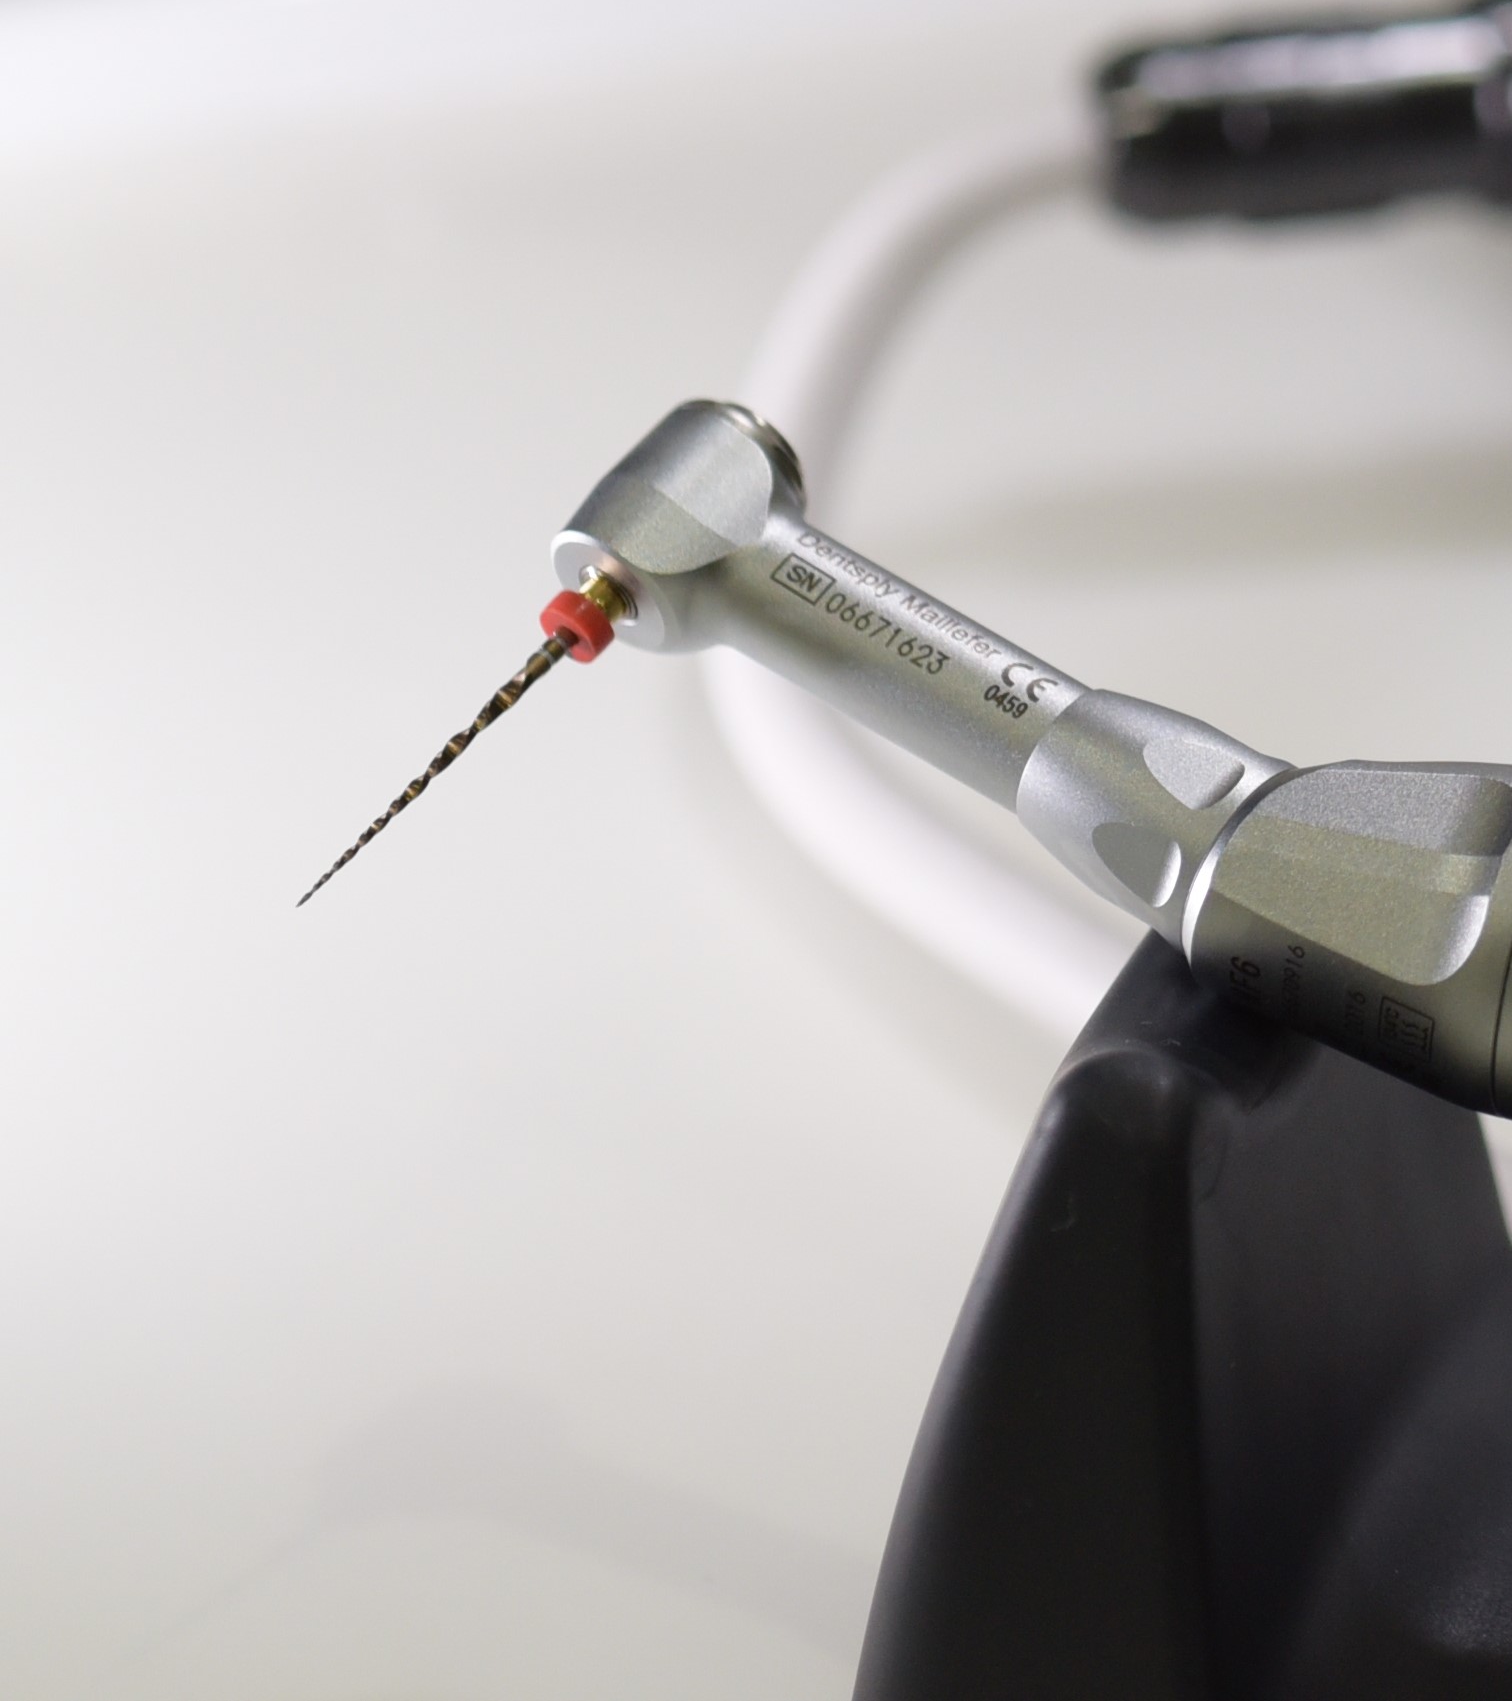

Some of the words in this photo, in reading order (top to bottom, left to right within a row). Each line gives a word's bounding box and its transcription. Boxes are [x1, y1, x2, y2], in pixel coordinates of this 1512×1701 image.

[797, 531, 900, 599] Dentsply
[899, 593, 1003, 661] Maillefer
[825, 591, 950, 676] 06671623
[983, 684, 1030, 720] 0459
